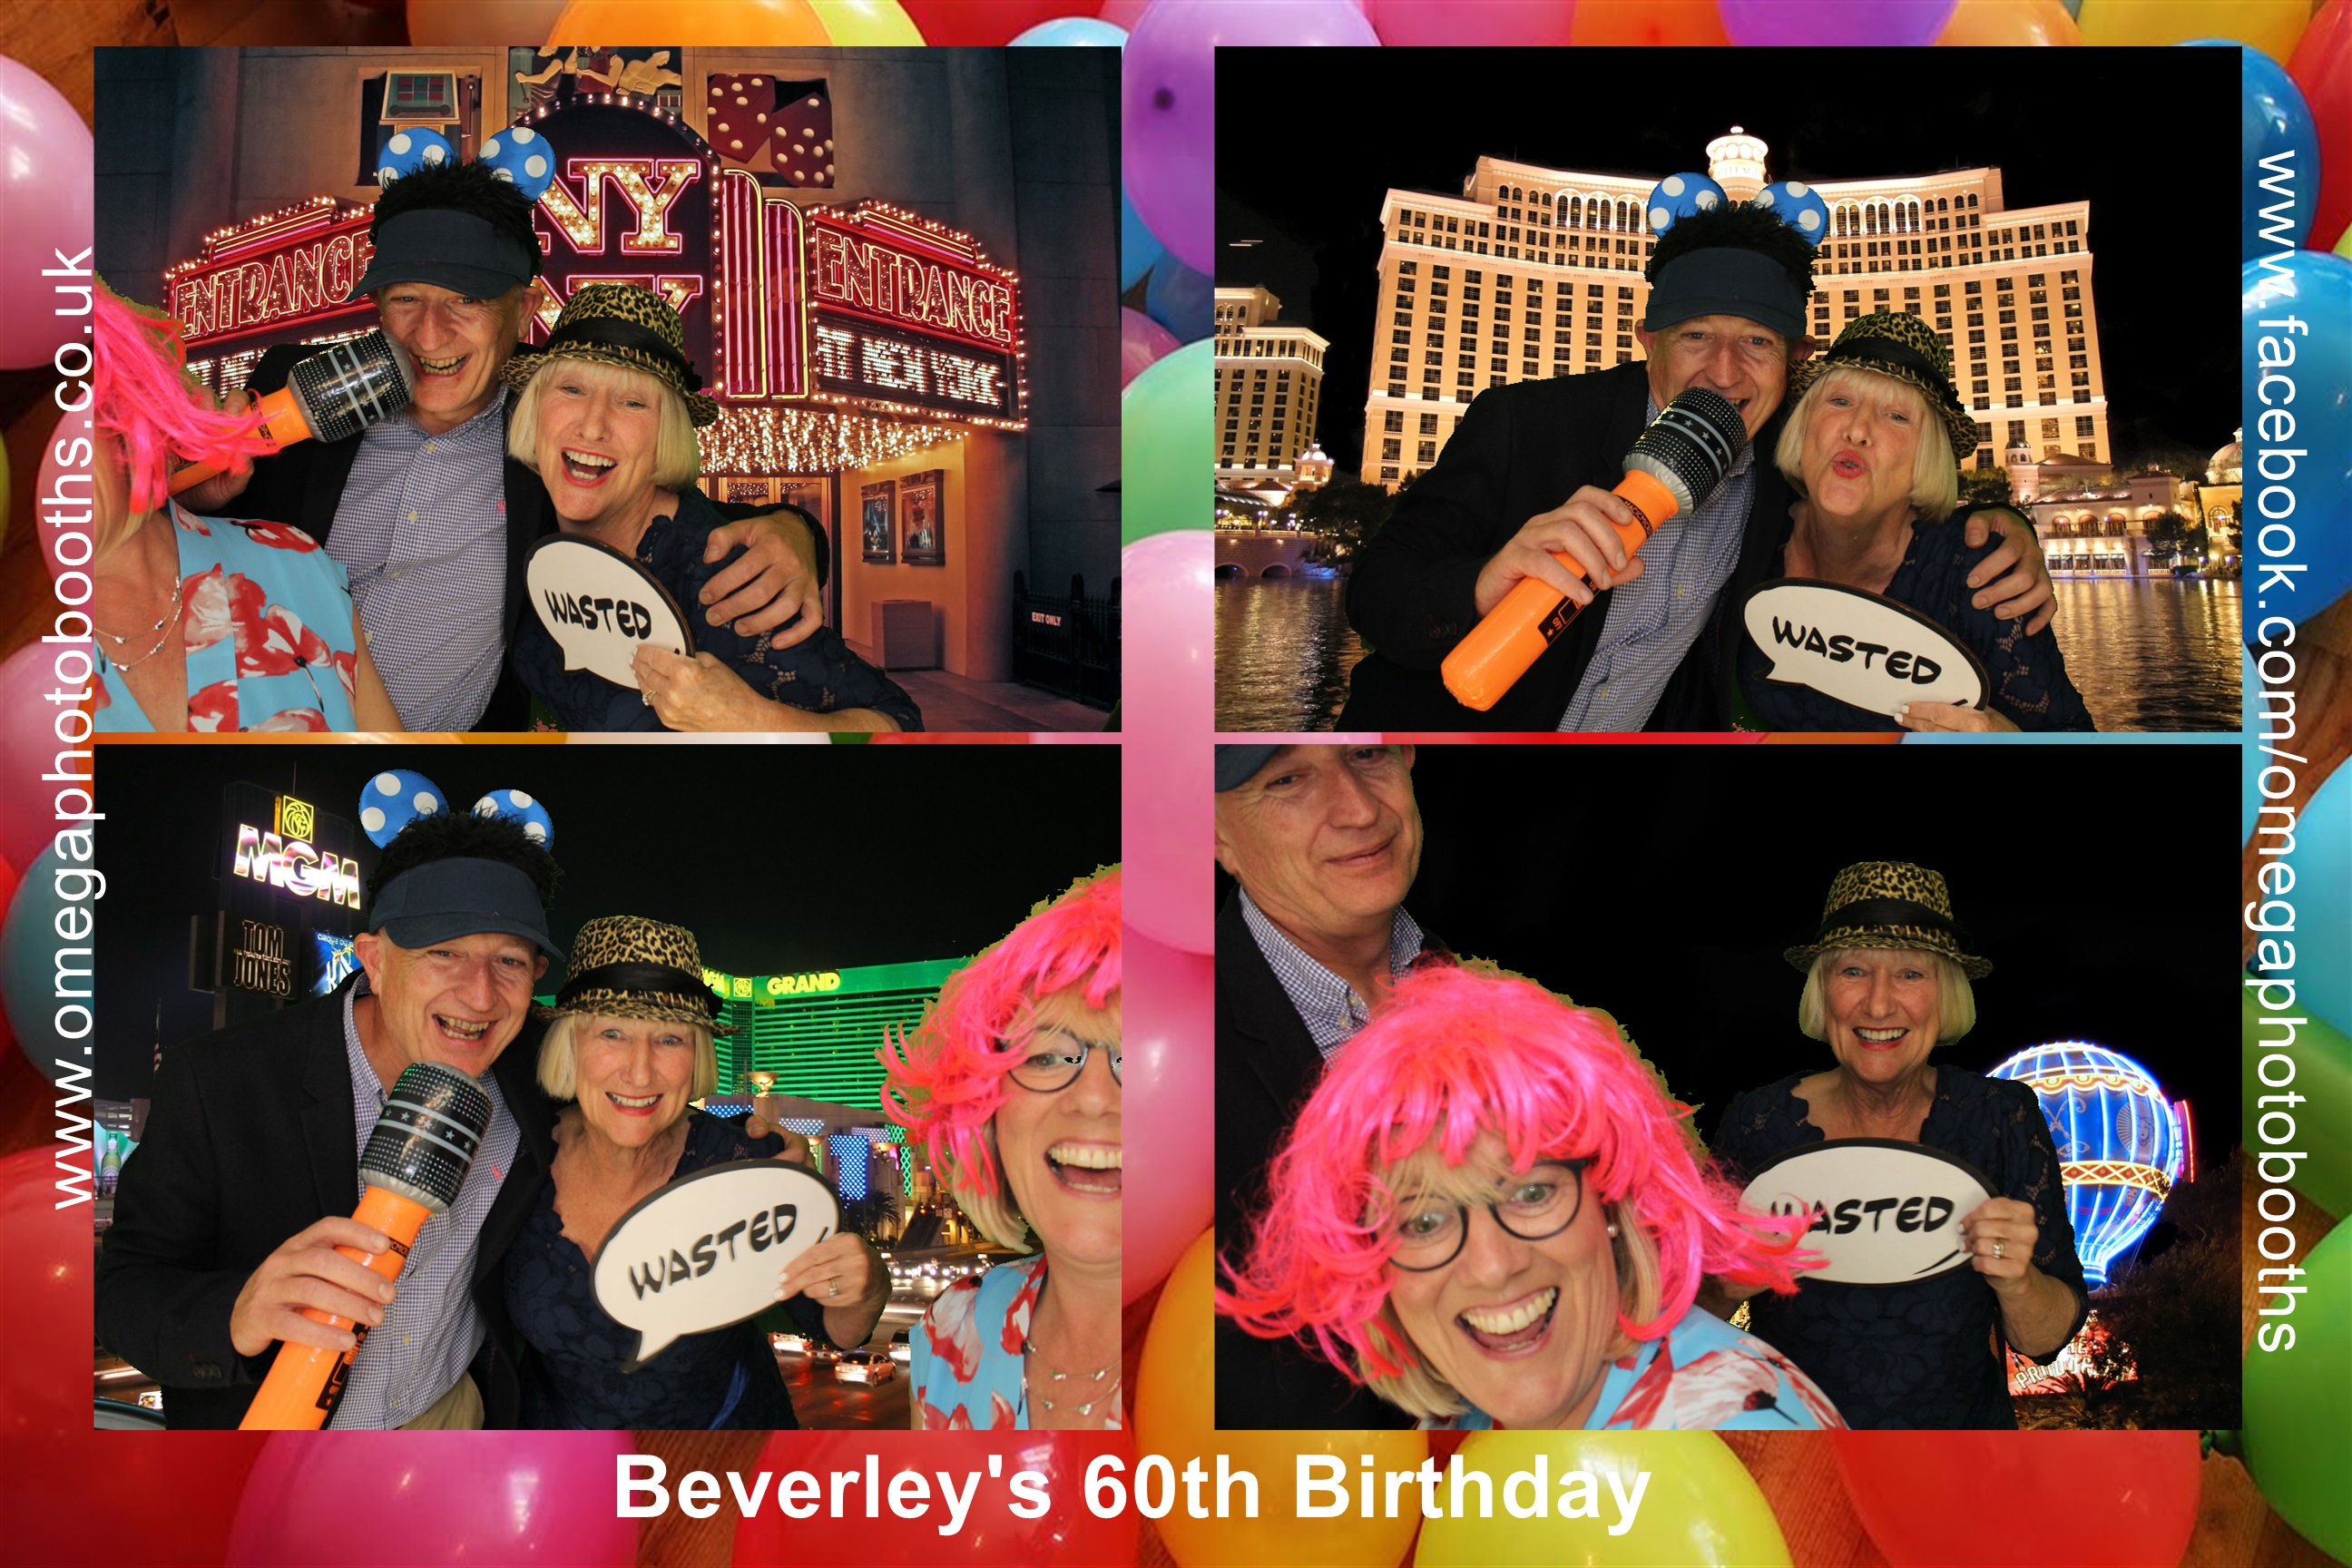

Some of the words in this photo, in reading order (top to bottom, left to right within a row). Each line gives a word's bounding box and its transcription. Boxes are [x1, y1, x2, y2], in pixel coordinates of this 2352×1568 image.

[530, 158, 701, 256] NY
[816, 228, 1012, 344] ENTRANCE
[544, 589, 652, 641] WASTED
[1032, 612, 1044, 623] EXIT
[1044, 614, 1061, 626] ONLY
[1772, 616, 1941, 685] WASTED
[233, 823, 360, 910] MGM
[242, 919, 284, 959] TOM
[318, 934, 338, 946] CIRQUE
[234, 955, 291, 996] JONES
[767, 972, 841, 995] GRAND
[628, 1203, 798, 1301] WASTED
